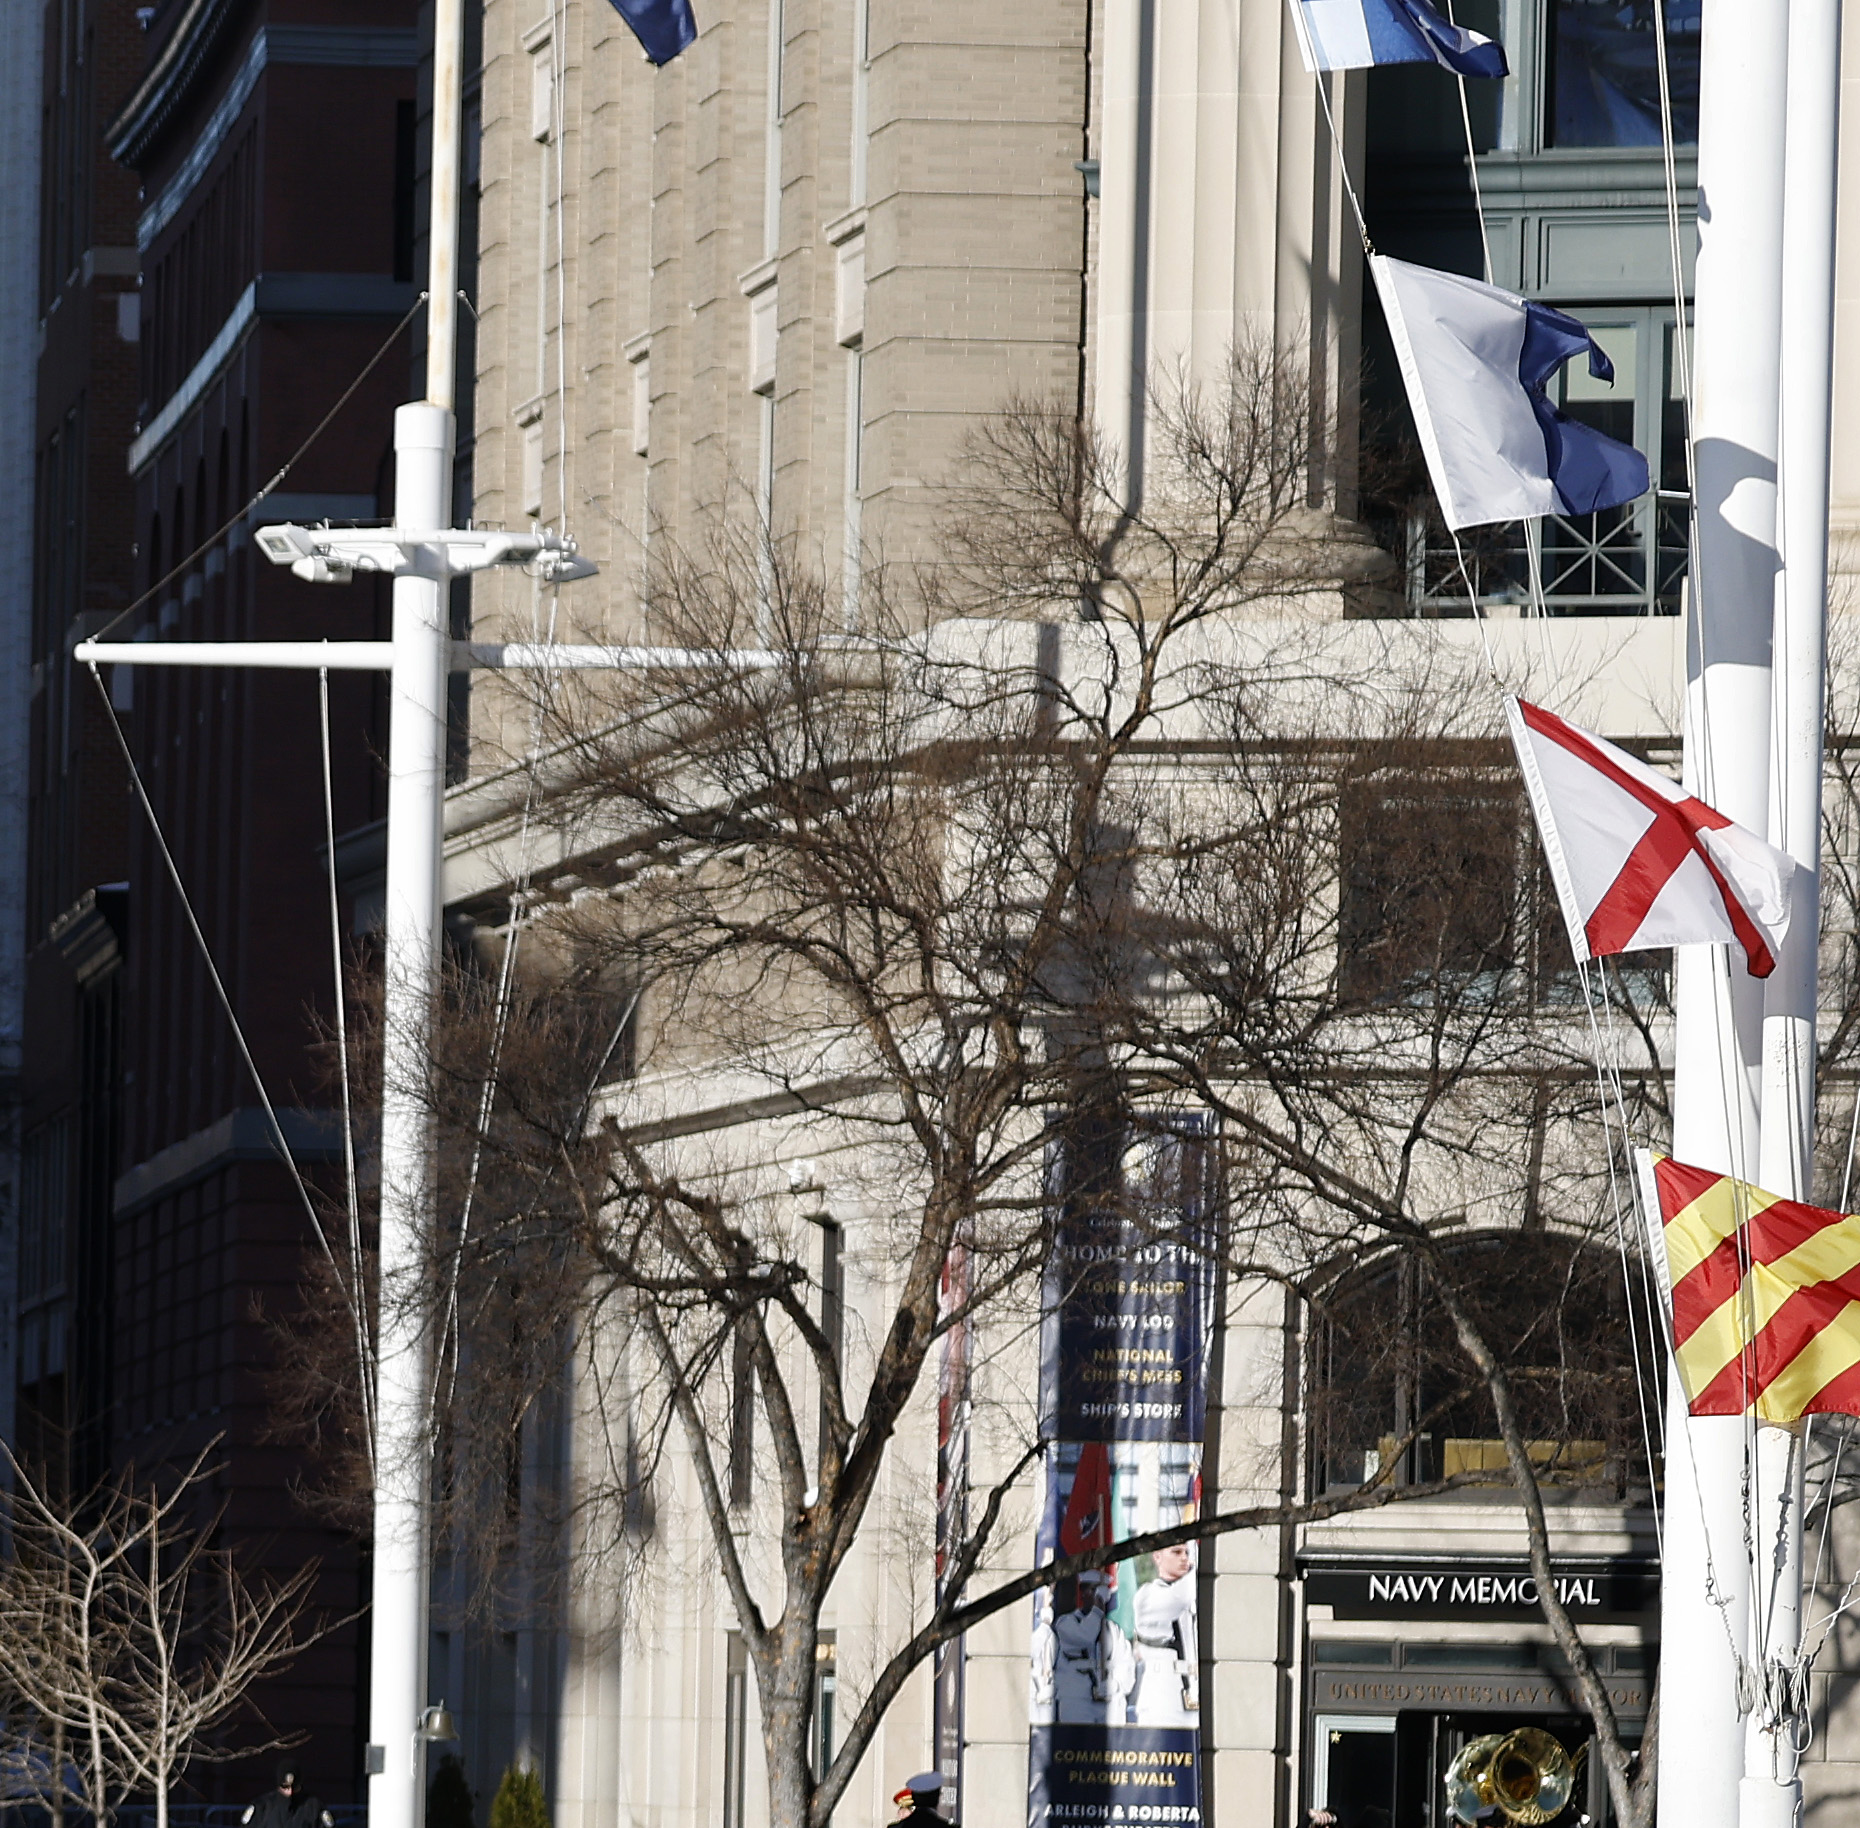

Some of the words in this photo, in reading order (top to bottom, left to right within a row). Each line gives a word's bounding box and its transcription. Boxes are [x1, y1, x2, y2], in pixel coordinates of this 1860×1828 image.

[1086, 1280, 1126, 1295] ONE
[1094, 1314, 1138, 1330] NAVY
[1094, 1348, 1174, 1364] NATIONAL
[1142, 1369, 1183, 1384] MESS
[1081, 1402, 1130, 1417] SHIP'S
[1133, 1402, 1183, 1419] STORE
[1368, 1574, 1445, 1603] NAVY
[1449, 1576, 1601, 1606] MEMOIAL
[1329, 1683, 1410, 1701] UNITED
[1413, 1684, 1493, 1703] STATES
[1497, 1686, 1557, 1705] NAVY
[1053, 1750, 1194, 1767] COMMEMORATIVE
[1069, 1770, 1129, 1786] PLAQUE
[1132, 1771, 1176, 1787] WALL
[1043, 1803, 1109, 1820] ARLEIGH
[1112, 1804, 1125, 1821] &
[1128, 1805, 1201, 1822] ROBERTA
